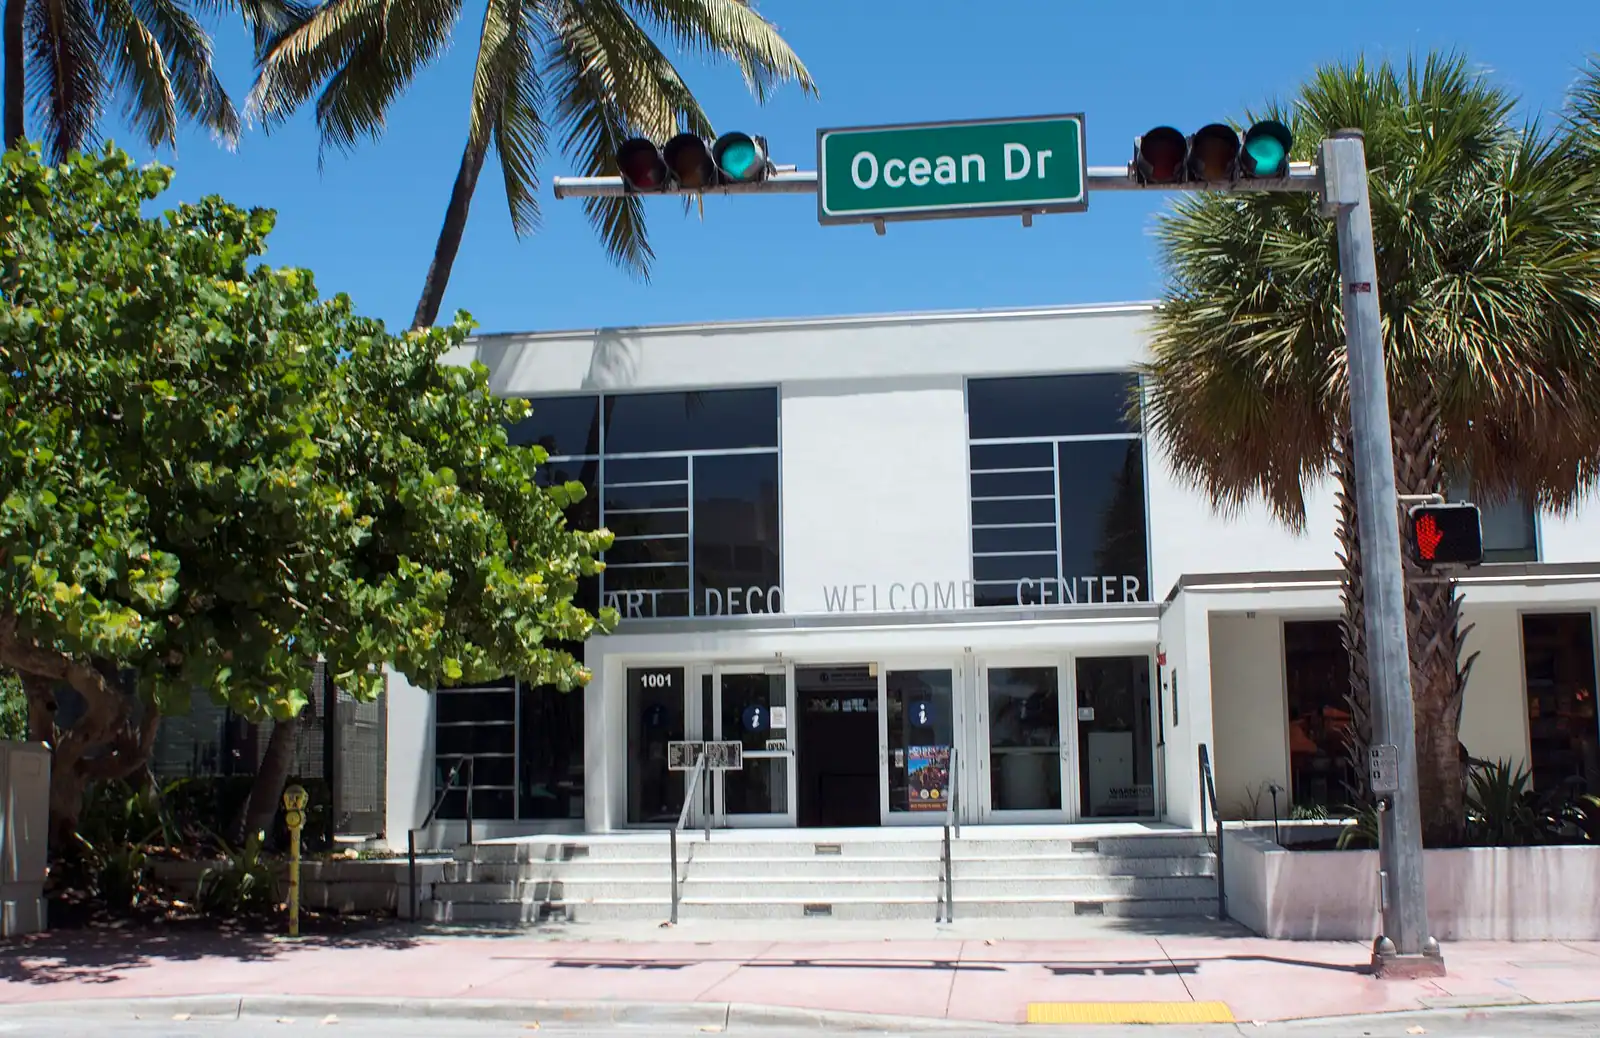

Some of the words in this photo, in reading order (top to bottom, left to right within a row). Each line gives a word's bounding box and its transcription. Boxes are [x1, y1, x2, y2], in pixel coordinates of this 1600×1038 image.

[851, 150, 986, 190] Ocean
[1003, 143, 1052, 181] Dr
[607, 590, 662, 619] ART
[704, 585, 785, 616] DECO
[1016, 575, 1140, 607] CENTER
[641, 673, 671, 688] 1001
